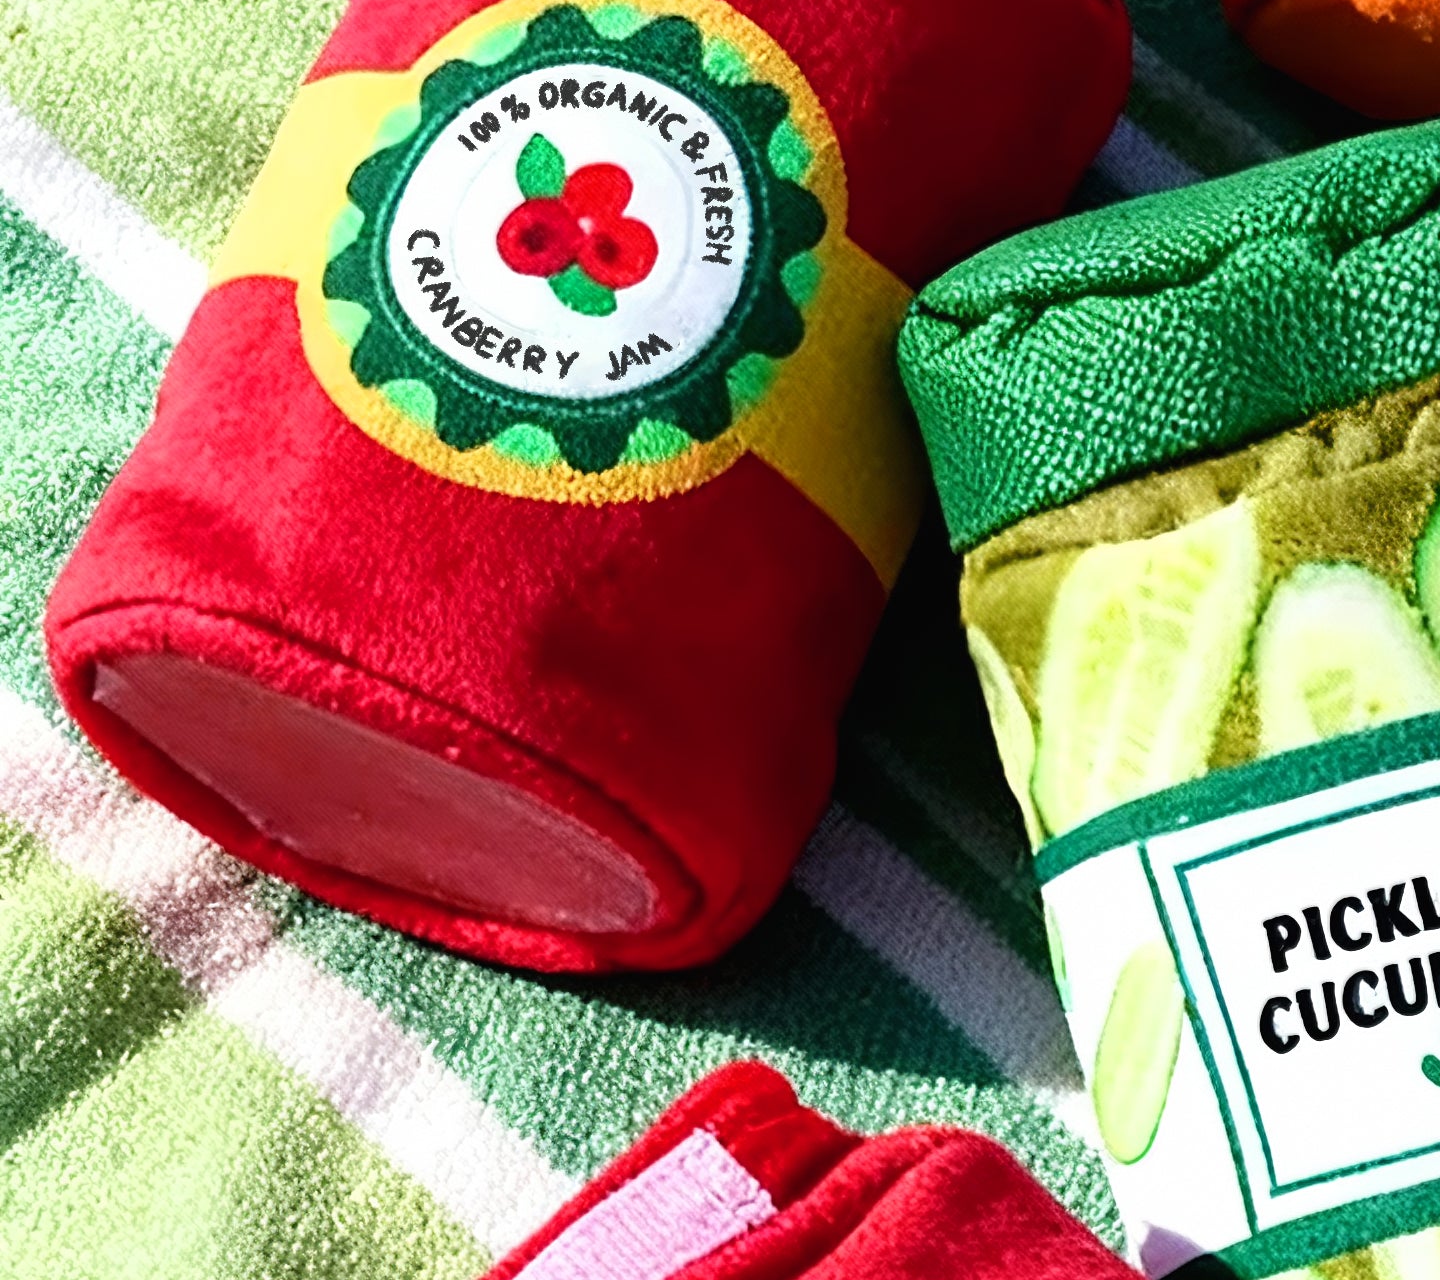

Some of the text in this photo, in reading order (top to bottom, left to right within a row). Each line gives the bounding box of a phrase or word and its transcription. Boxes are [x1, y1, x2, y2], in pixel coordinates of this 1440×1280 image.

[538, 78, 688, 142] ORGANIC
[680, 131, 710, 163] &
[694, 162, 735, 266] FRESH
[407, 229, 673, 381] CRANBERRY JAM
